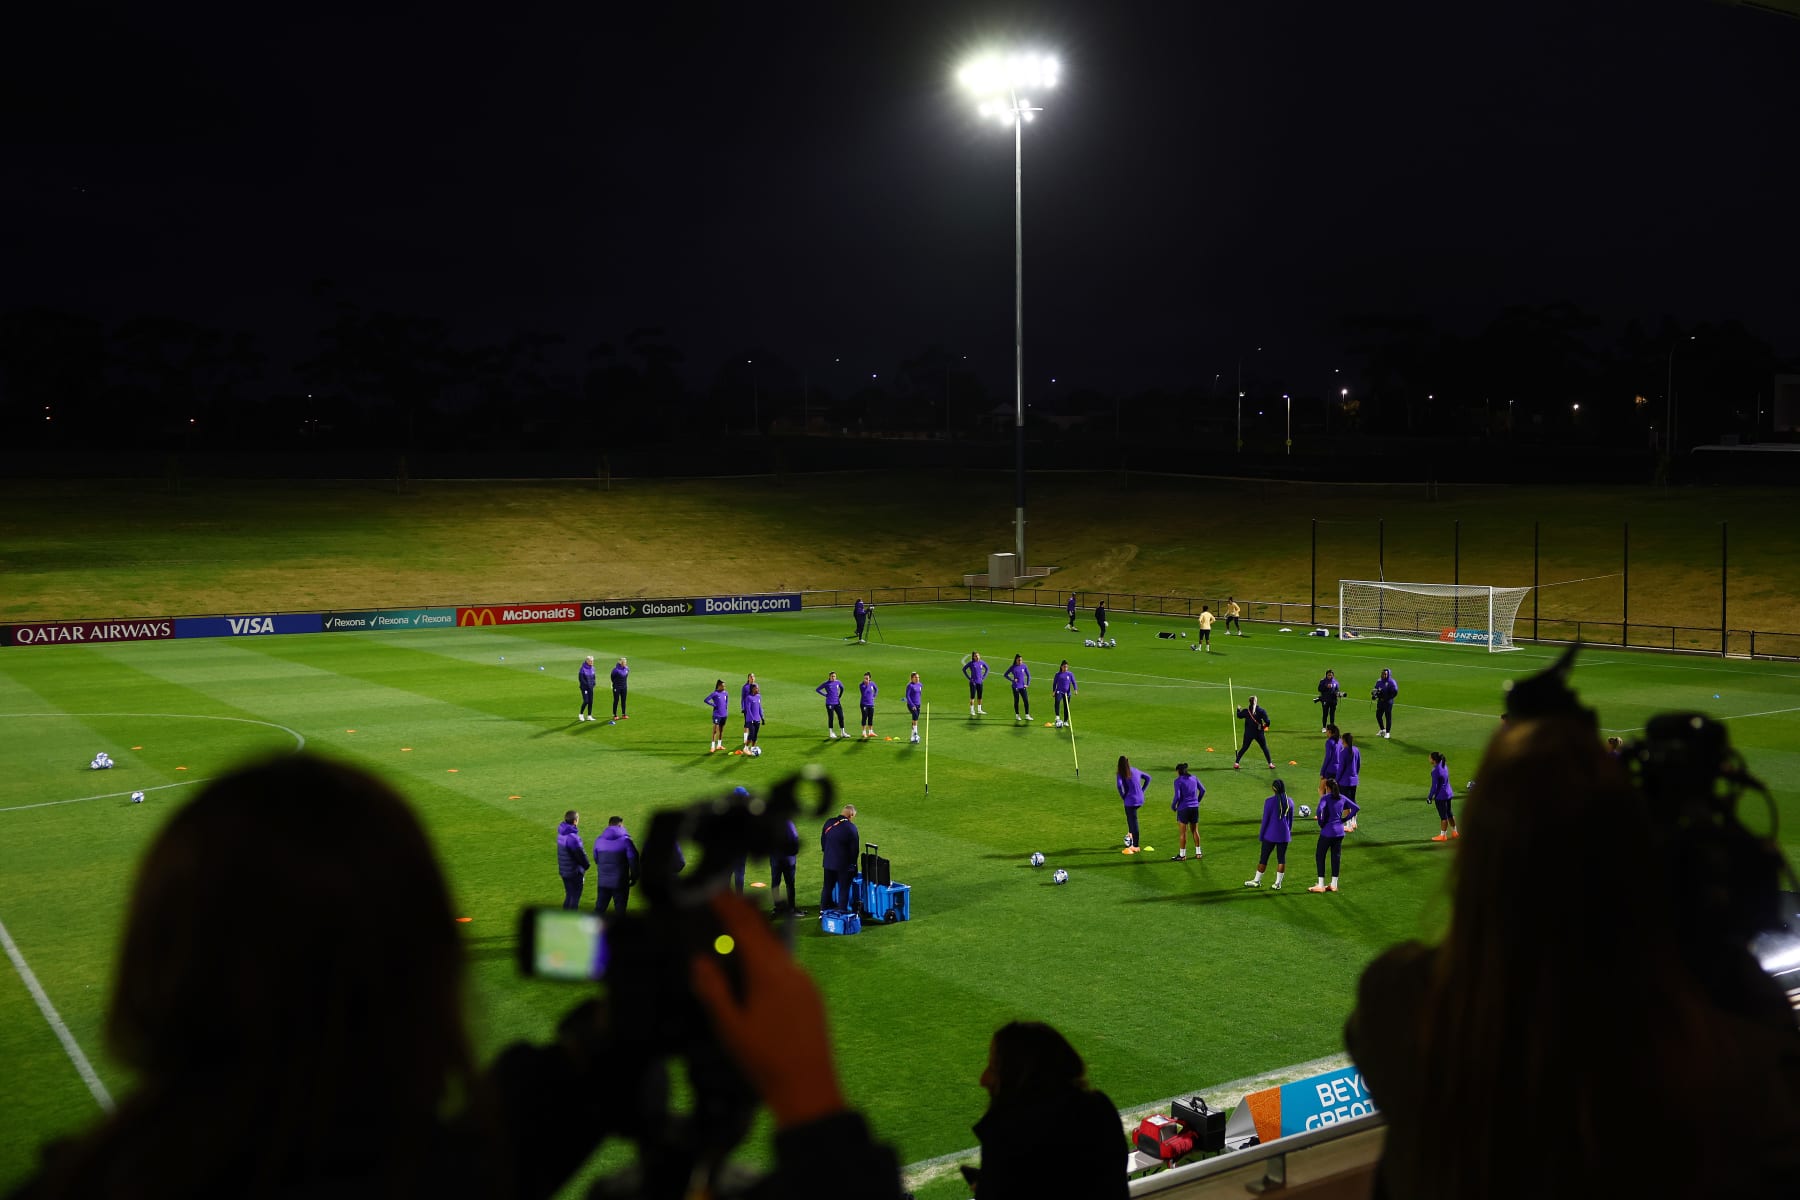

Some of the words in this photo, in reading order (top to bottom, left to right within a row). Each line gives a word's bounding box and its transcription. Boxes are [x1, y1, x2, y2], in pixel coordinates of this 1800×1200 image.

[583, 604, 630, 618] Globant
[642, 601, 686, 616] Globant
[705, 596, 791, 614] Booking.com
[334, 617, 366, 628] Rexona
[380, 615, 409, 627] Rexona
[422, 613, 452, 625] Rexona
[502, 607, 575, 623] McDonald's
[16, 626, 87, 645] QATAR
[89, 622, 171, 640] AIRWAYS
[226, 617, 274, 635] VISA
